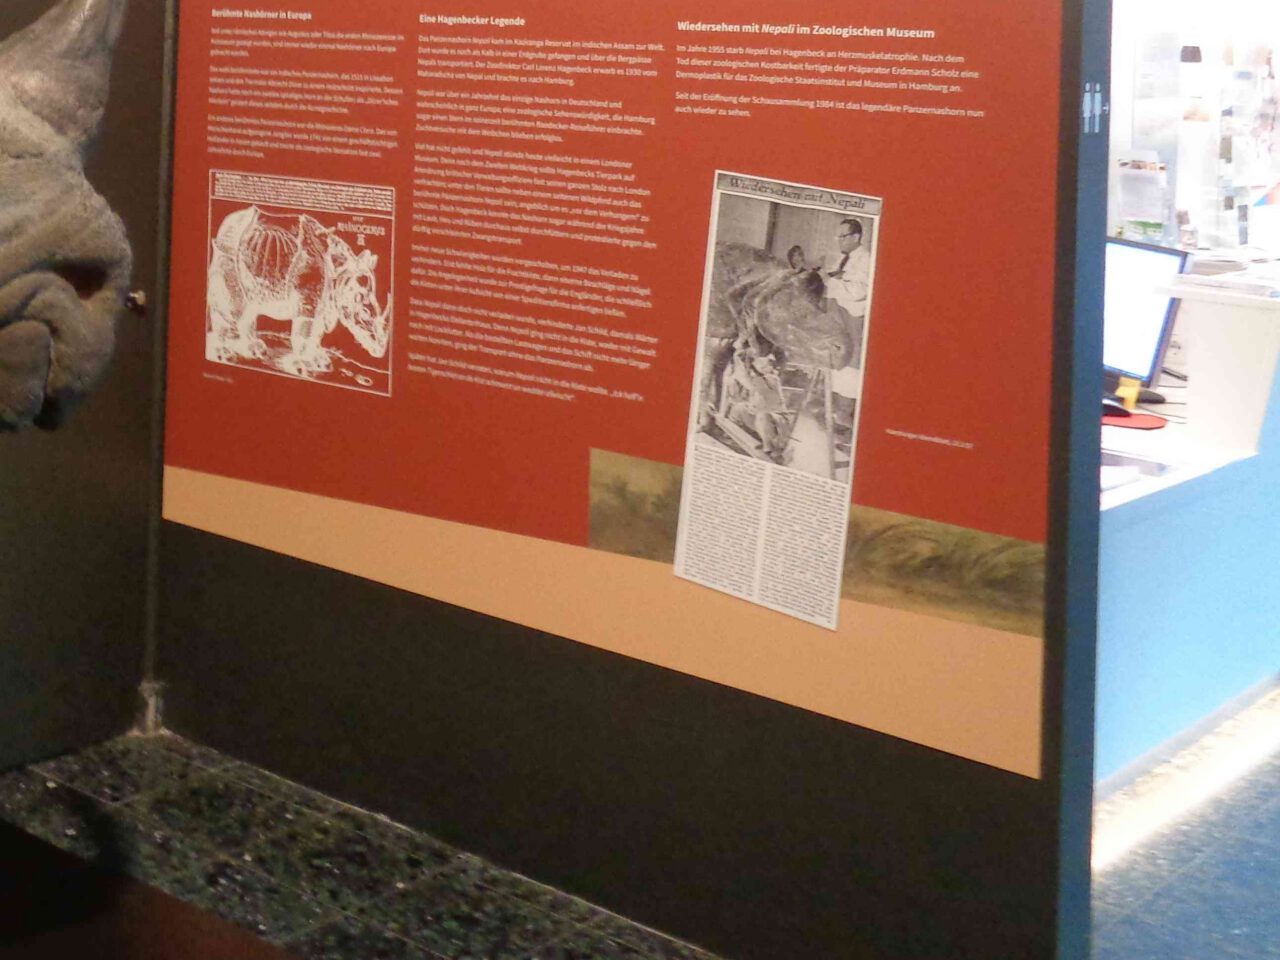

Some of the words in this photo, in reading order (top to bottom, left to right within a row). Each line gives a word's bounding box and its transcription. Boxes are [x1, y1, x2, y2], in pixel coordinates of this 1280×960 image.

[279, 9, 286, 19] in
[287, 10, 312, 20] Europa
[419, 13, 437, 24] Eine
[437, 13, 489, 26] Hagenbecker
[490, 16, 525, 28] Legende
[677, 20, 740, 32] Wiedersehen
[742, 22, 759, 32] mit
[761, 23, 796, 35] Nepali
[796, 23, 810, 34] im
[812, 24, 884, 38] Zoologischen
[886, 27, 935, 38] Museum
